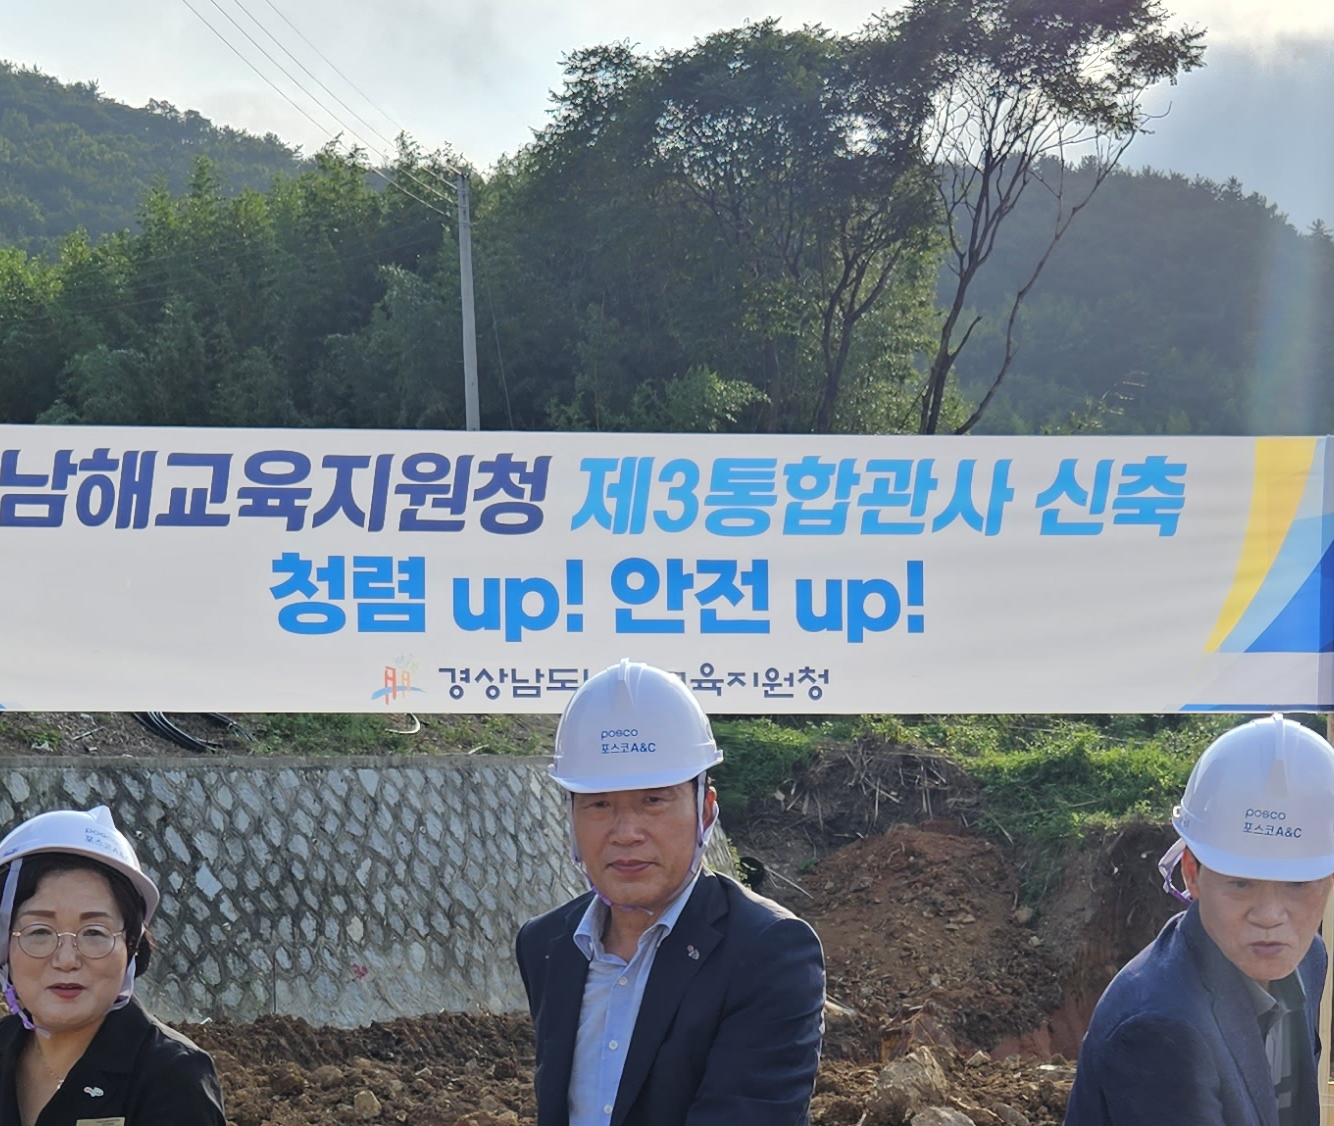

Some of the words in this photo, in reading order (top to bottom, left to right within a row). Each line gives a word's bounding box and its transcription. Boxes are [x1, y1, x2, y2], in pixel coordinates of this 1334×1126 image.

[0, 448, 549, 536] 남해교육지원청
[570, 454, 1016, 538] 제3통합관사
[1034, 455, 1188, 538] 신축
[269, 551, 427, 637] 청렴
[452, 558, 585, 644] up!
[610, 556, 772, 636] 안전
[794, 559, 926, 645] up!
[438, 662, 829, 701] 경상남도육지원청
[601, 729, 638, 741] posco
[601, 742, 656, 754] 포스코A&C
[1245, 808, 1286, 820] posco
[1243, 822, 1302, 838] 포스코A&C
